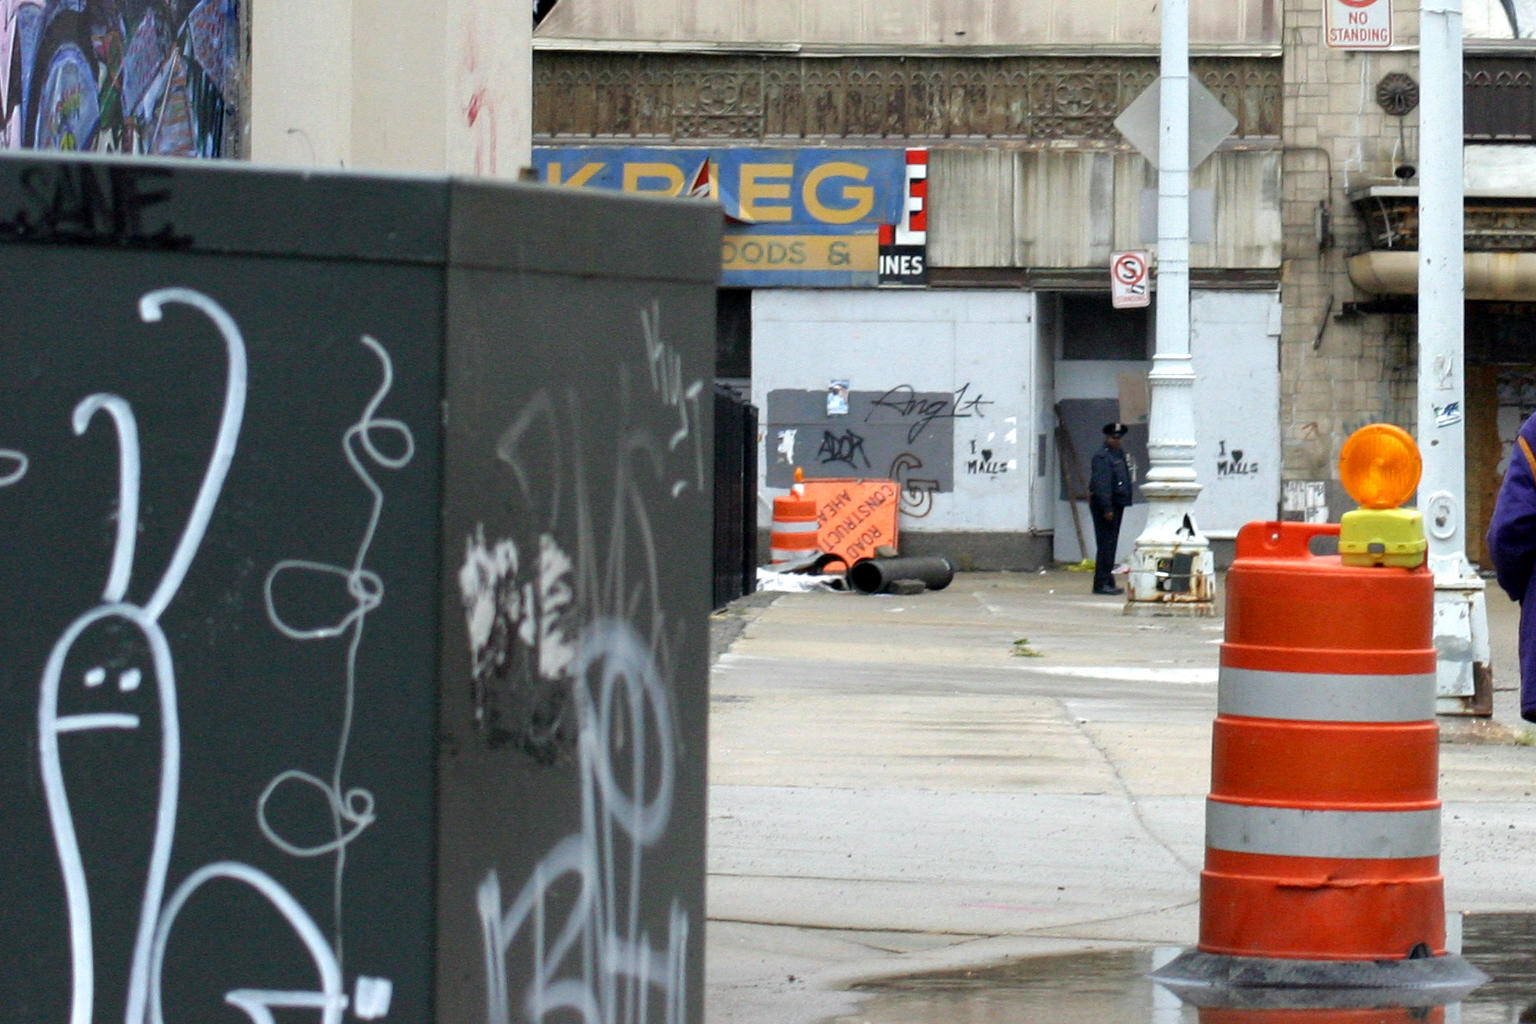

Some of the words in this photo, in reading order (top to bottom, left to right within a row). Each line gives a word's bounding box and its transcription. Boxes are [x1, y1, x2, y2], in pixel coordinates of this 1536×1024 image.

[1349, 12, 1368, 25] NO
[1330, 28, 1387, 42] STANDING
[827, 241, 850, 265] &
[879, 255, 923, 275] INES
[970, 439, 976, 455] I
[1219, 440, 1227, 457] I
[967, 460, 1008, 475] MALLS
[1217, 461, 1259, 476] MALLS
[818, 489, 852, 522] AHEA
[822, 485, 894, 551] CONSTRUCT
[846, 524, 882, 558] ROAD
